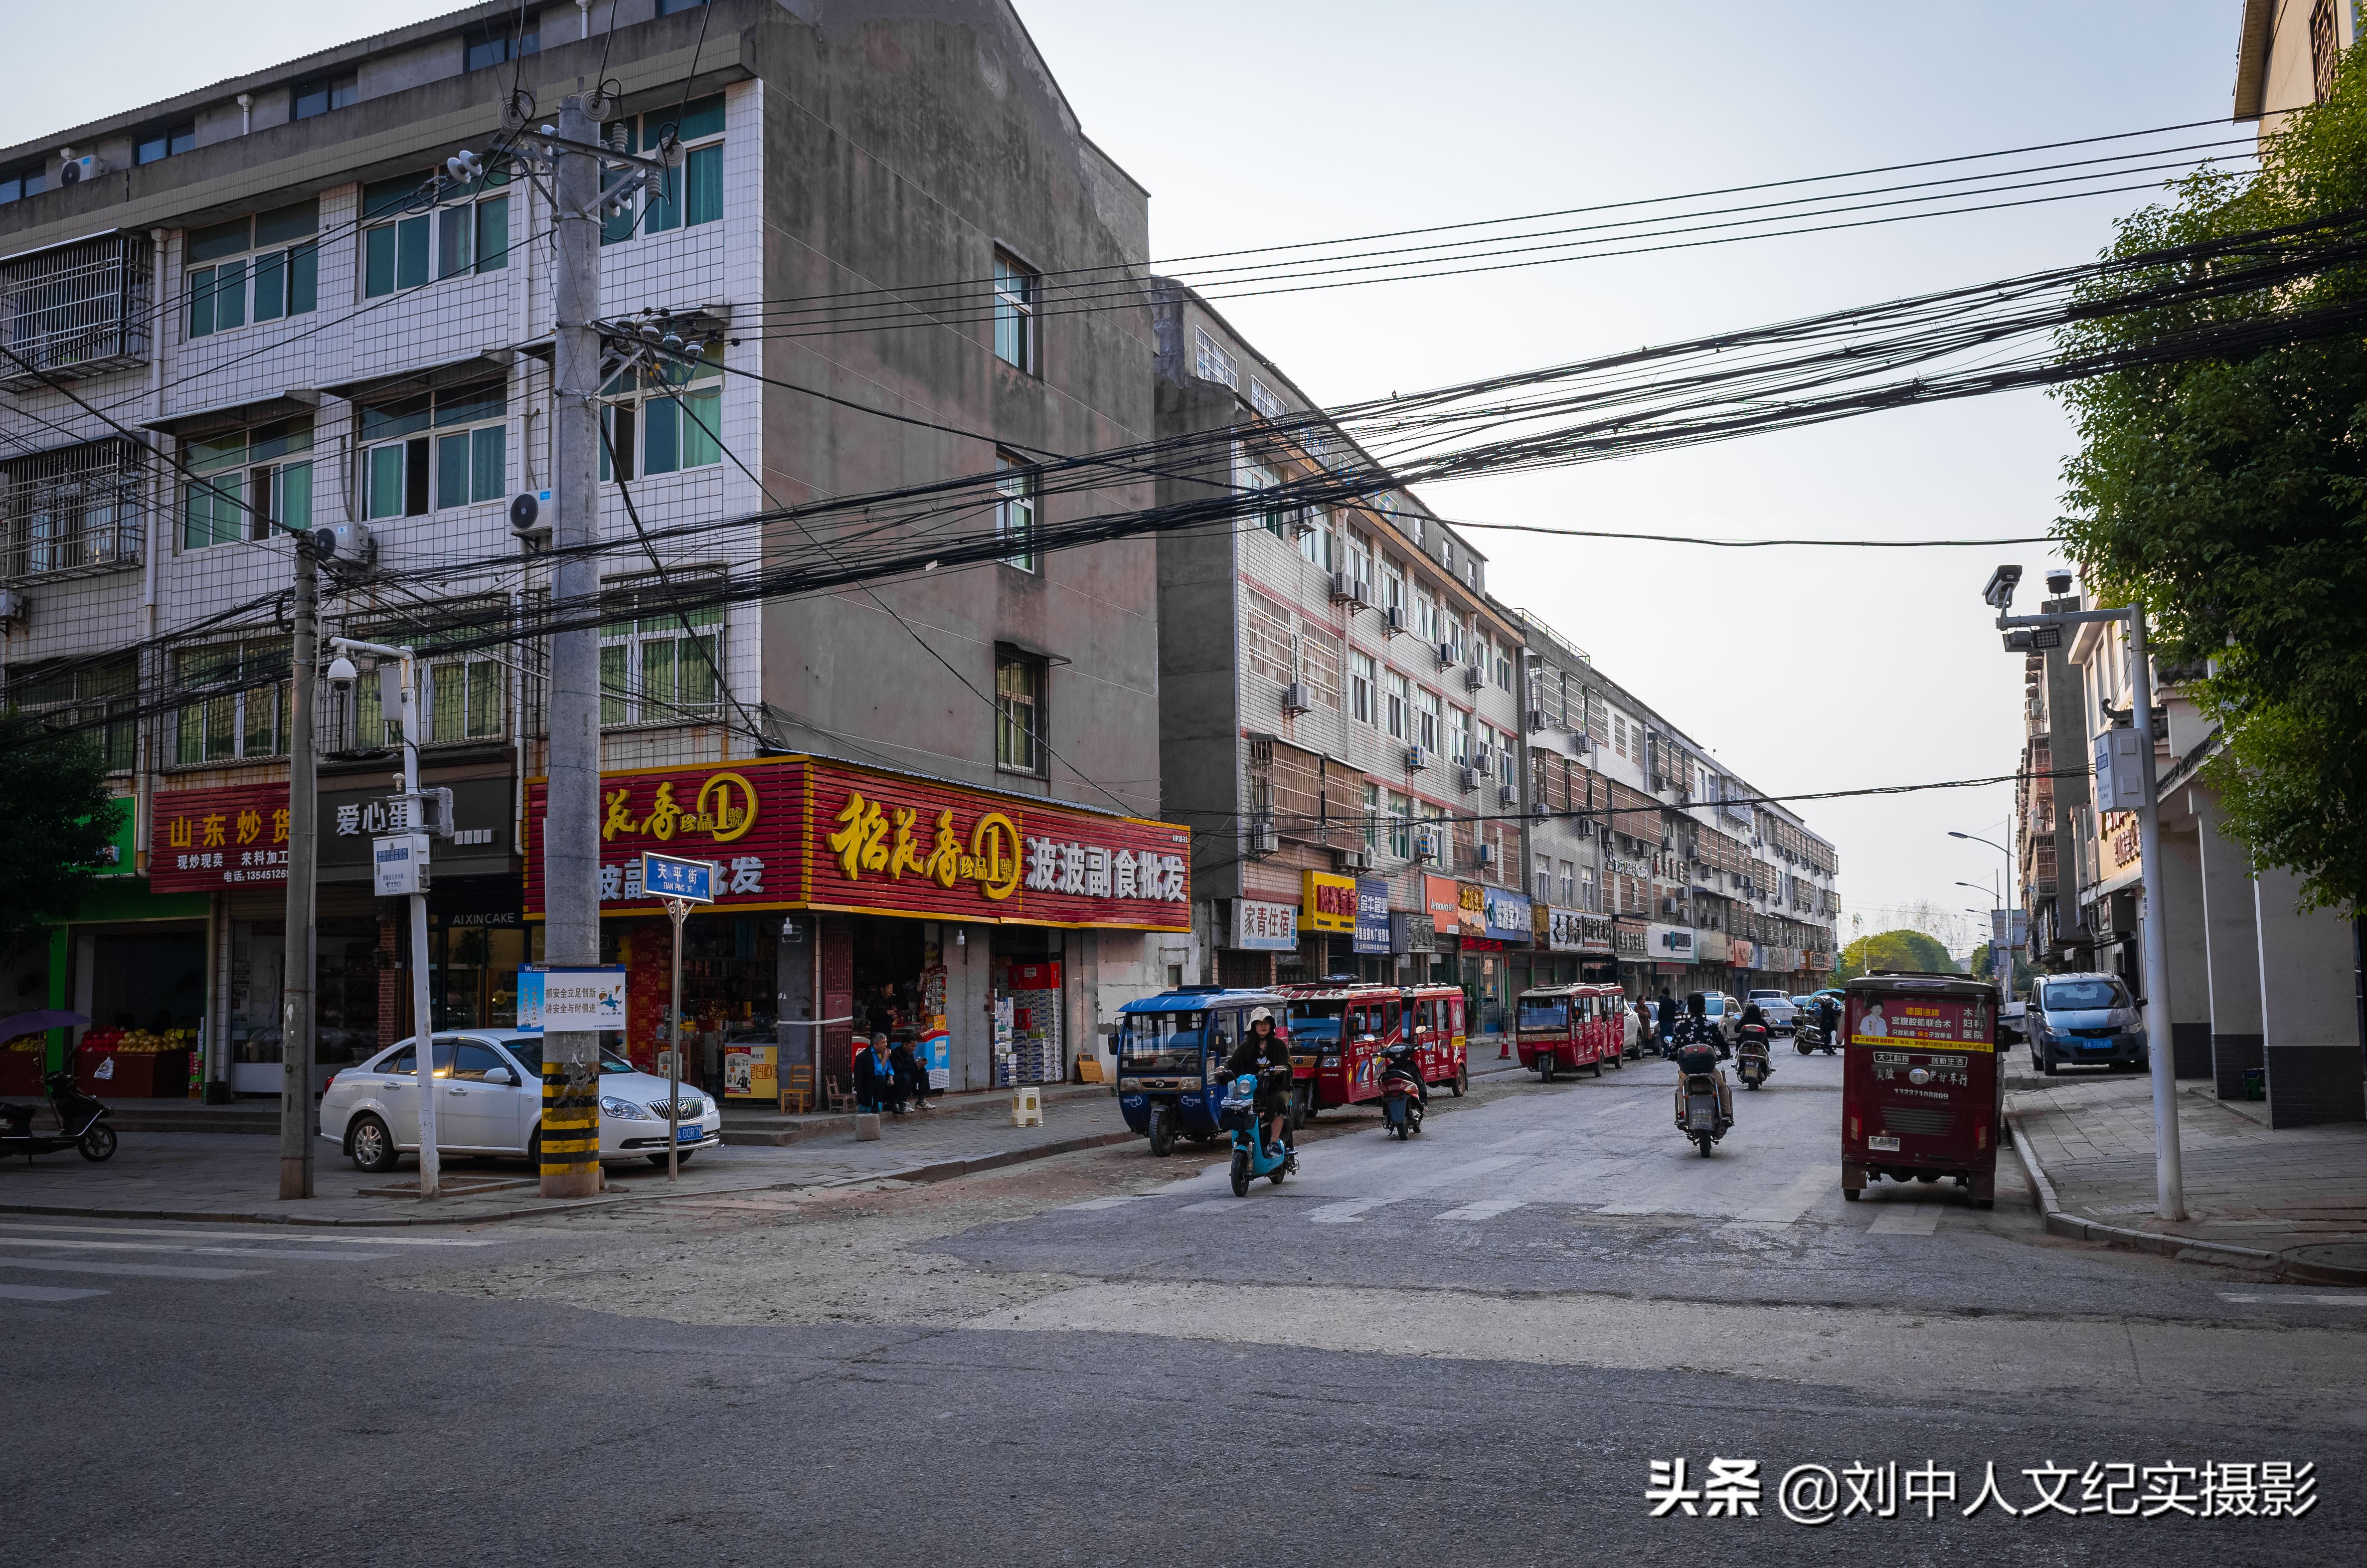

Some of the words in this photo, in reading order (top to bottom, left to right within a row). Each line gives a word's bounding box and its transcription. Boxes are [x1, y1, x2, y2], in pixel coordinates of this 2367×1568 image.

[170, 809, 290, 848] 山东炒货
[177, 853, 223, 870] 现炒现卖
[241, 850, 288, 866] 来料加工
[658, 863, 697, 884] 天平街
[1025, 837, 1187, 902] 波波副食批发
[663, 881, 674, 890] TIAN
[675, 883, 685, 892] PING
[1360, 894, 1388, 914] 金牛管业
[1430, 898, 1449, 911] lenovo
[1244, 905, 1289, 937] 家青住宿
[545, 988, 596, 998] 抓安全立足创新
[545, 1003, 596, 1014] 讲安全与时俱进
[1906, 1007, 1940, 1017] 德国狼牌
[1891, 1017, 1951, 1028] 宫腹腔镜联合术
[1963, 1030, 1984, 1040] 医院
[1356, 1047, 1364, 1055] 大江
[1425, 1054, 1435, 1064] 大江
[1878, 1053, 1909, 1062] 大江科技
[1931, 1056, 1964, 1065] 创新生活
[1929, 1070, 1969, 1086] 老甘车行
[1894, 1088, 1949, 1099] 13237108809
